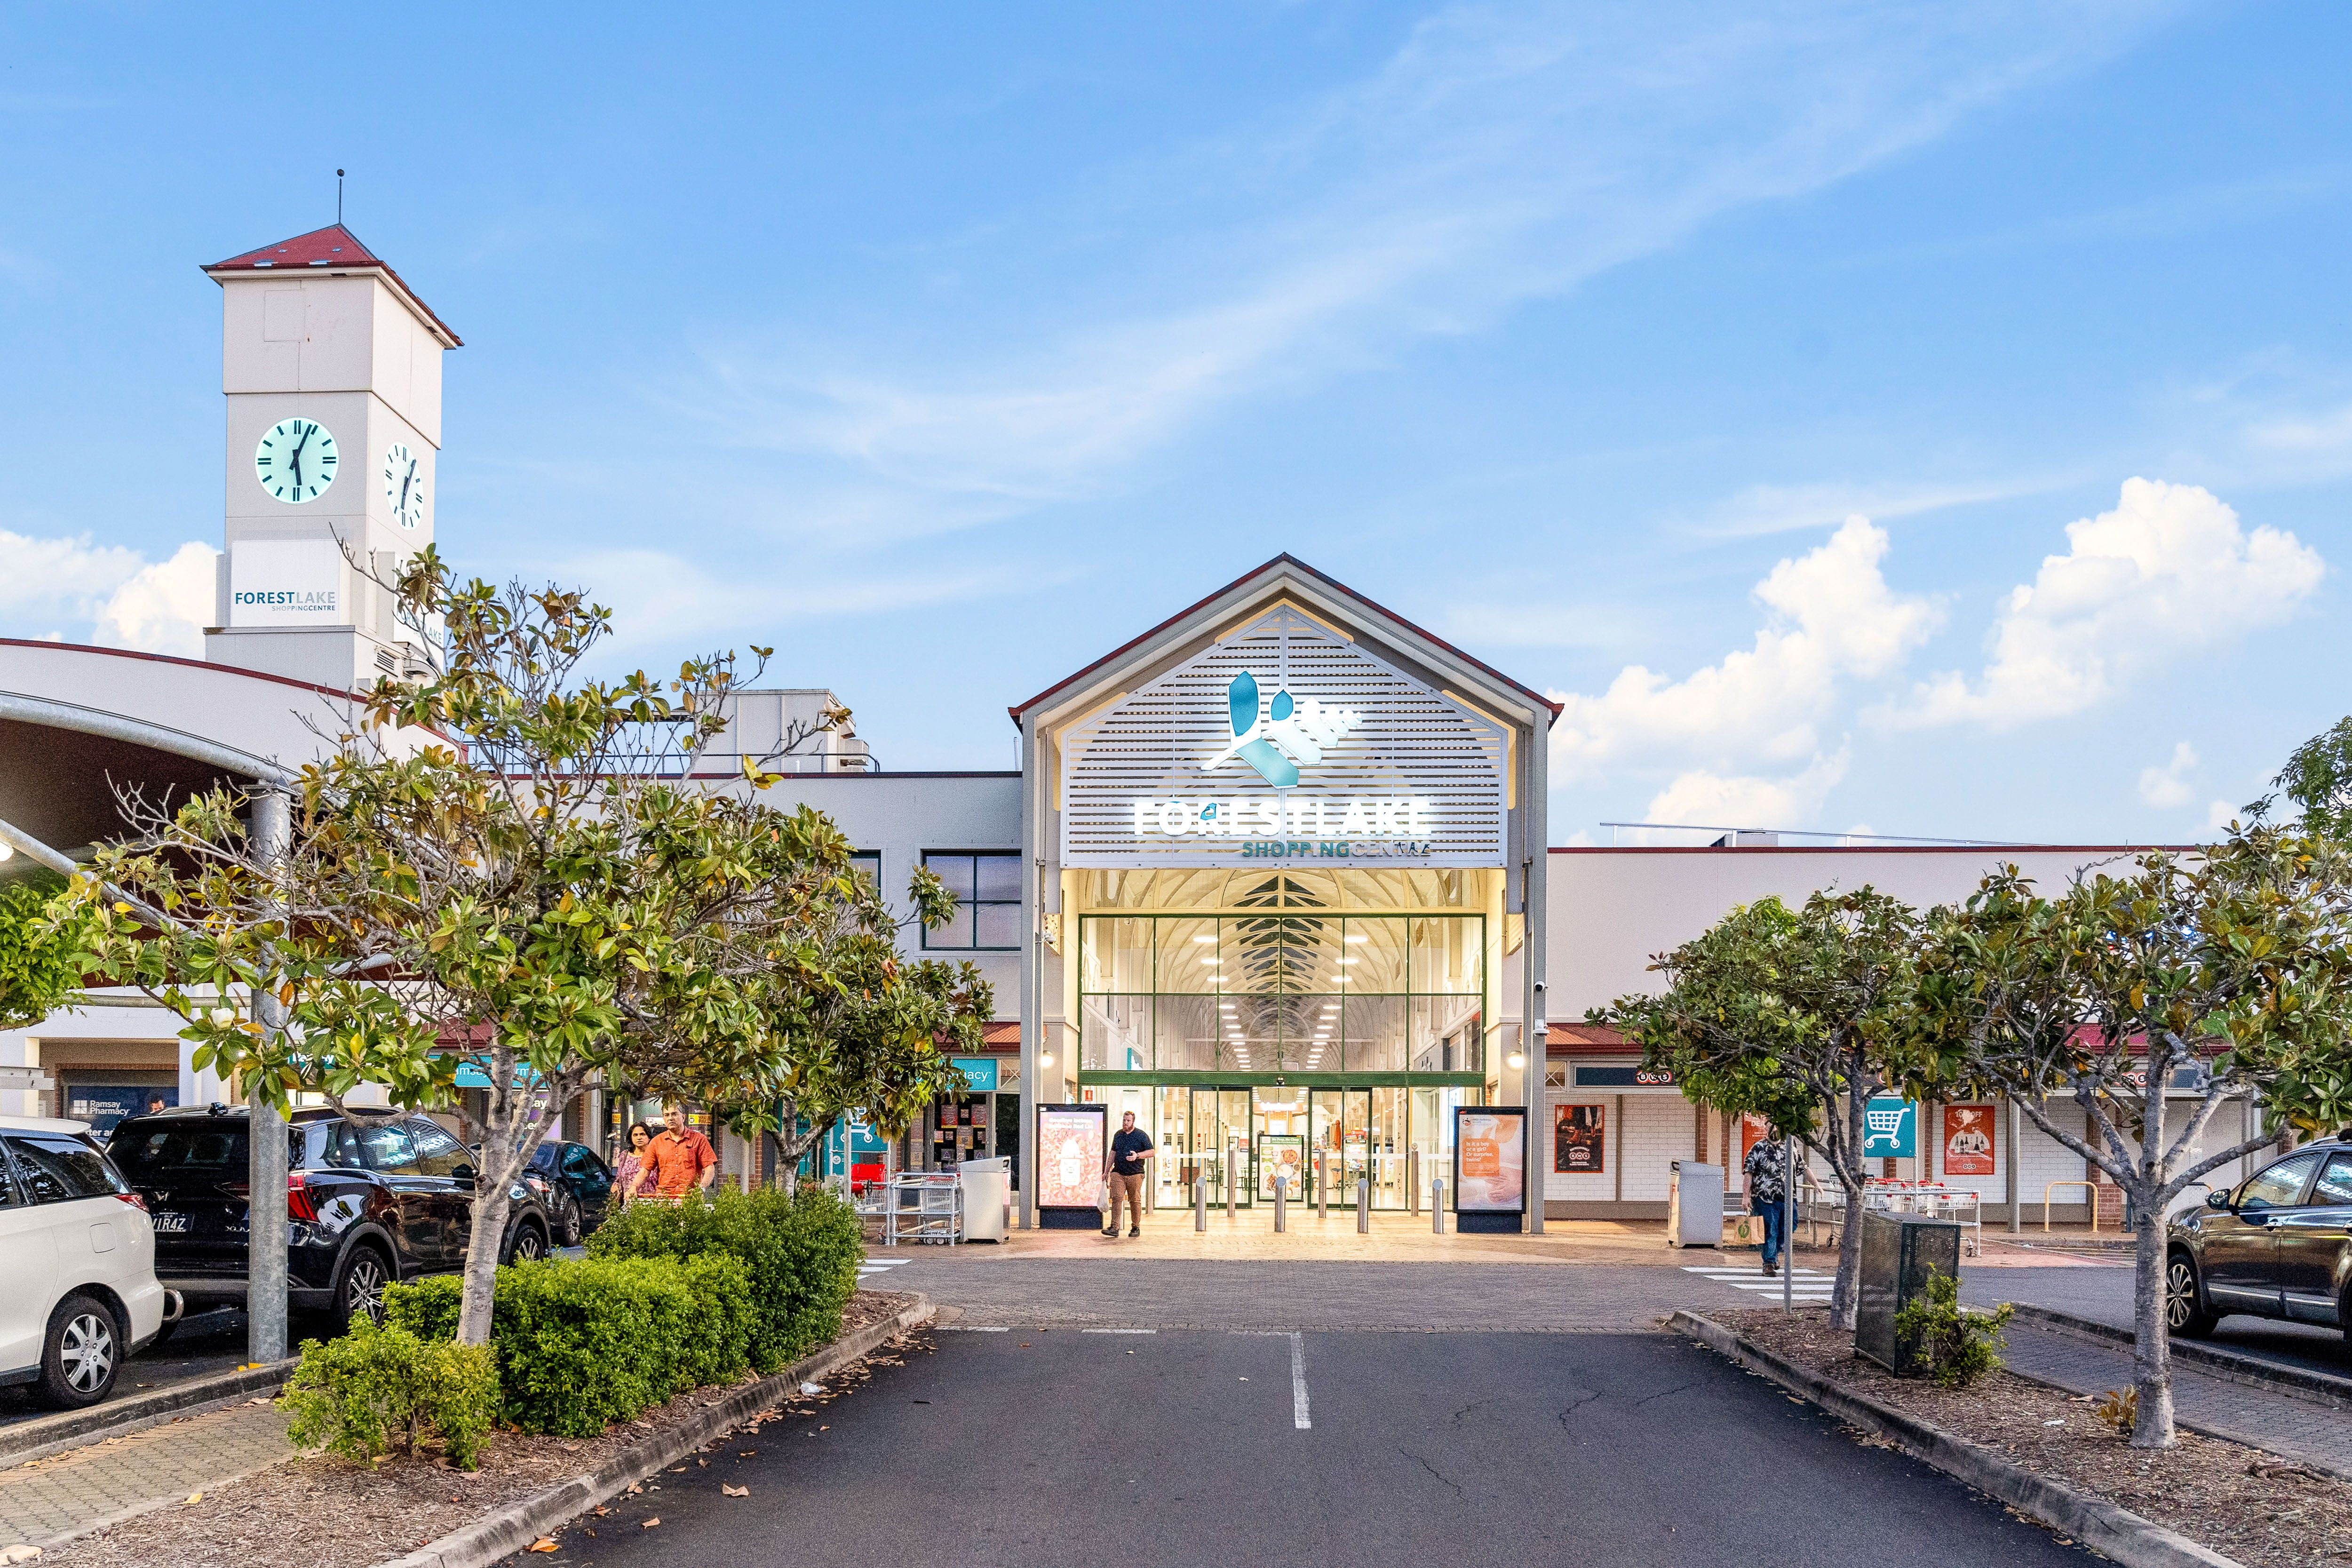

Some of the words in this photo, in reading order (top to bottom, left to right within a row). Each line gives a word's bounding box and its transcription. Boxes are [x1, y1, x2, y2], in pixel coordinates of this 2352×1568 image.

[235, 592, 335, 604] FORESTLAKE
[1134, 801, 1432, 836] FORESTLAKE
[90, 1100, 120, 1109] Ramsay
[90, 1107, 128, 1116] Pharmacy
